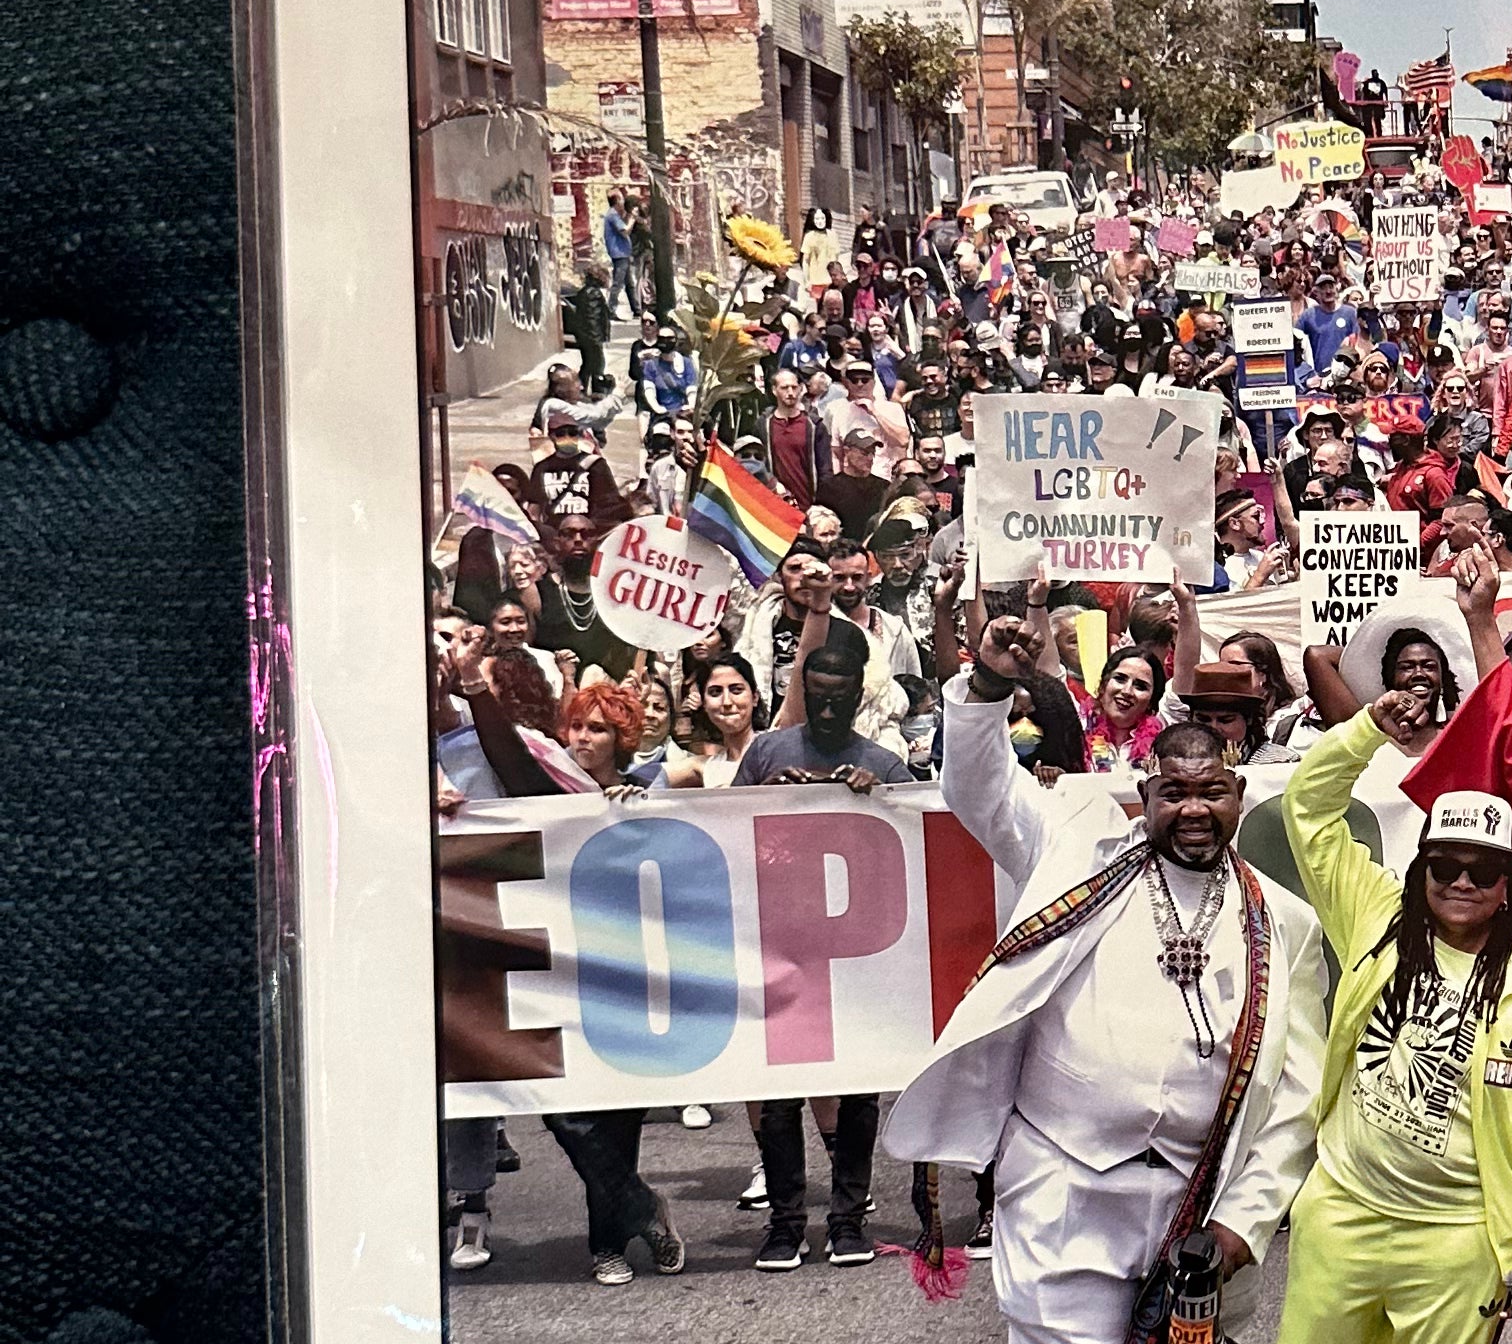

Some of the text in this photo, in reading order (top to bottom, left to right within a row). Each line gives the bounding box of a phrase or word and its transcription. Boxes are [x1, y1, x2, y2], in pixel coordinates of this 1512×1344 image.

[1276, 125, 1361, 150] No Justice
[1280, 156, 1361, 183] No Peace
[1377, 212, 1436, 237] NOTHING
[1375, 239, 1433, 261] ABOUT US
[1207, 271, 1248, 290] HEALS
[1377, 259, 1434, 281] WITHOUT
[1388, 277, 1432, 299] US!
[1270, 306, 1285, 314] FOR
[1155, 388, 1175, 397] END
[1004, 410, 1104, 461] HEAR
[1034, 466, 1146, 501] LGBTQ+
[1003, 511, 1192, 546] COMMUNITY in
[1042, 539, 1150, 570] TURKEY
[1303, 547, 1417, 570] CONVENTION
[1328, 573, 1398, 597] KEEPS
[1312, 600, 1378, 623] WOM
[1441, 817, 1478, 828] MARCH
[1172, 1325, 1209, 1344] OUT
